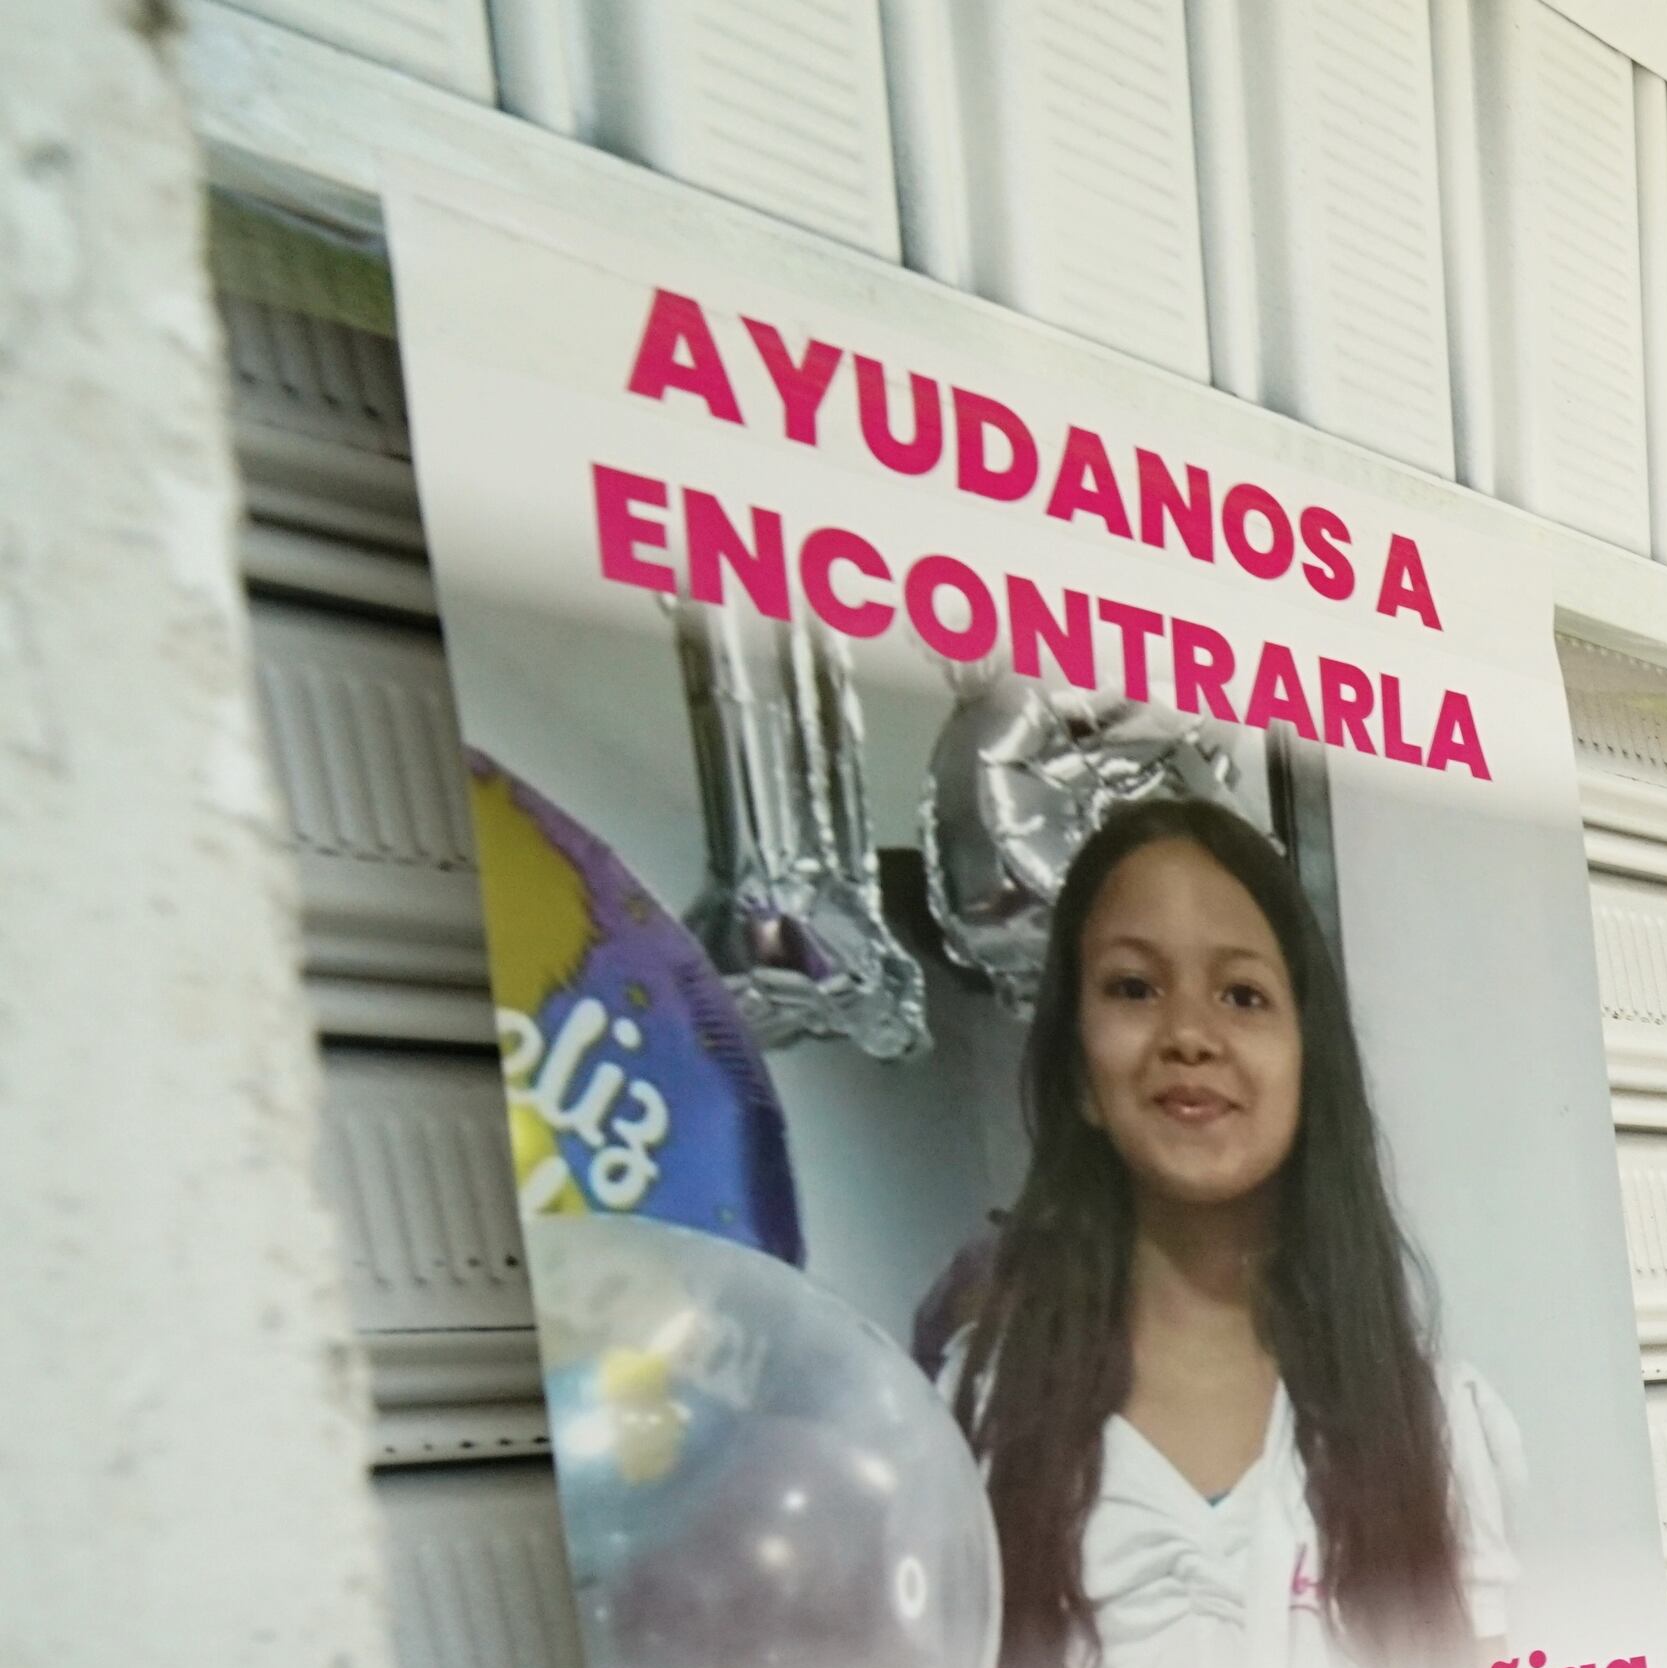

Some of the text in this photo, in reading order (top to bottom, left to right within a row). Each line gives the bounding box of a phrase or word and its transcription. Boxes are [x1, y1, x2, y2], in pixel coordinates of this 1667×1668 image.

[591, 462, 1493, 782] ENCONTRARLA
[627, 288, 1443, 632] AYUDANOS A
